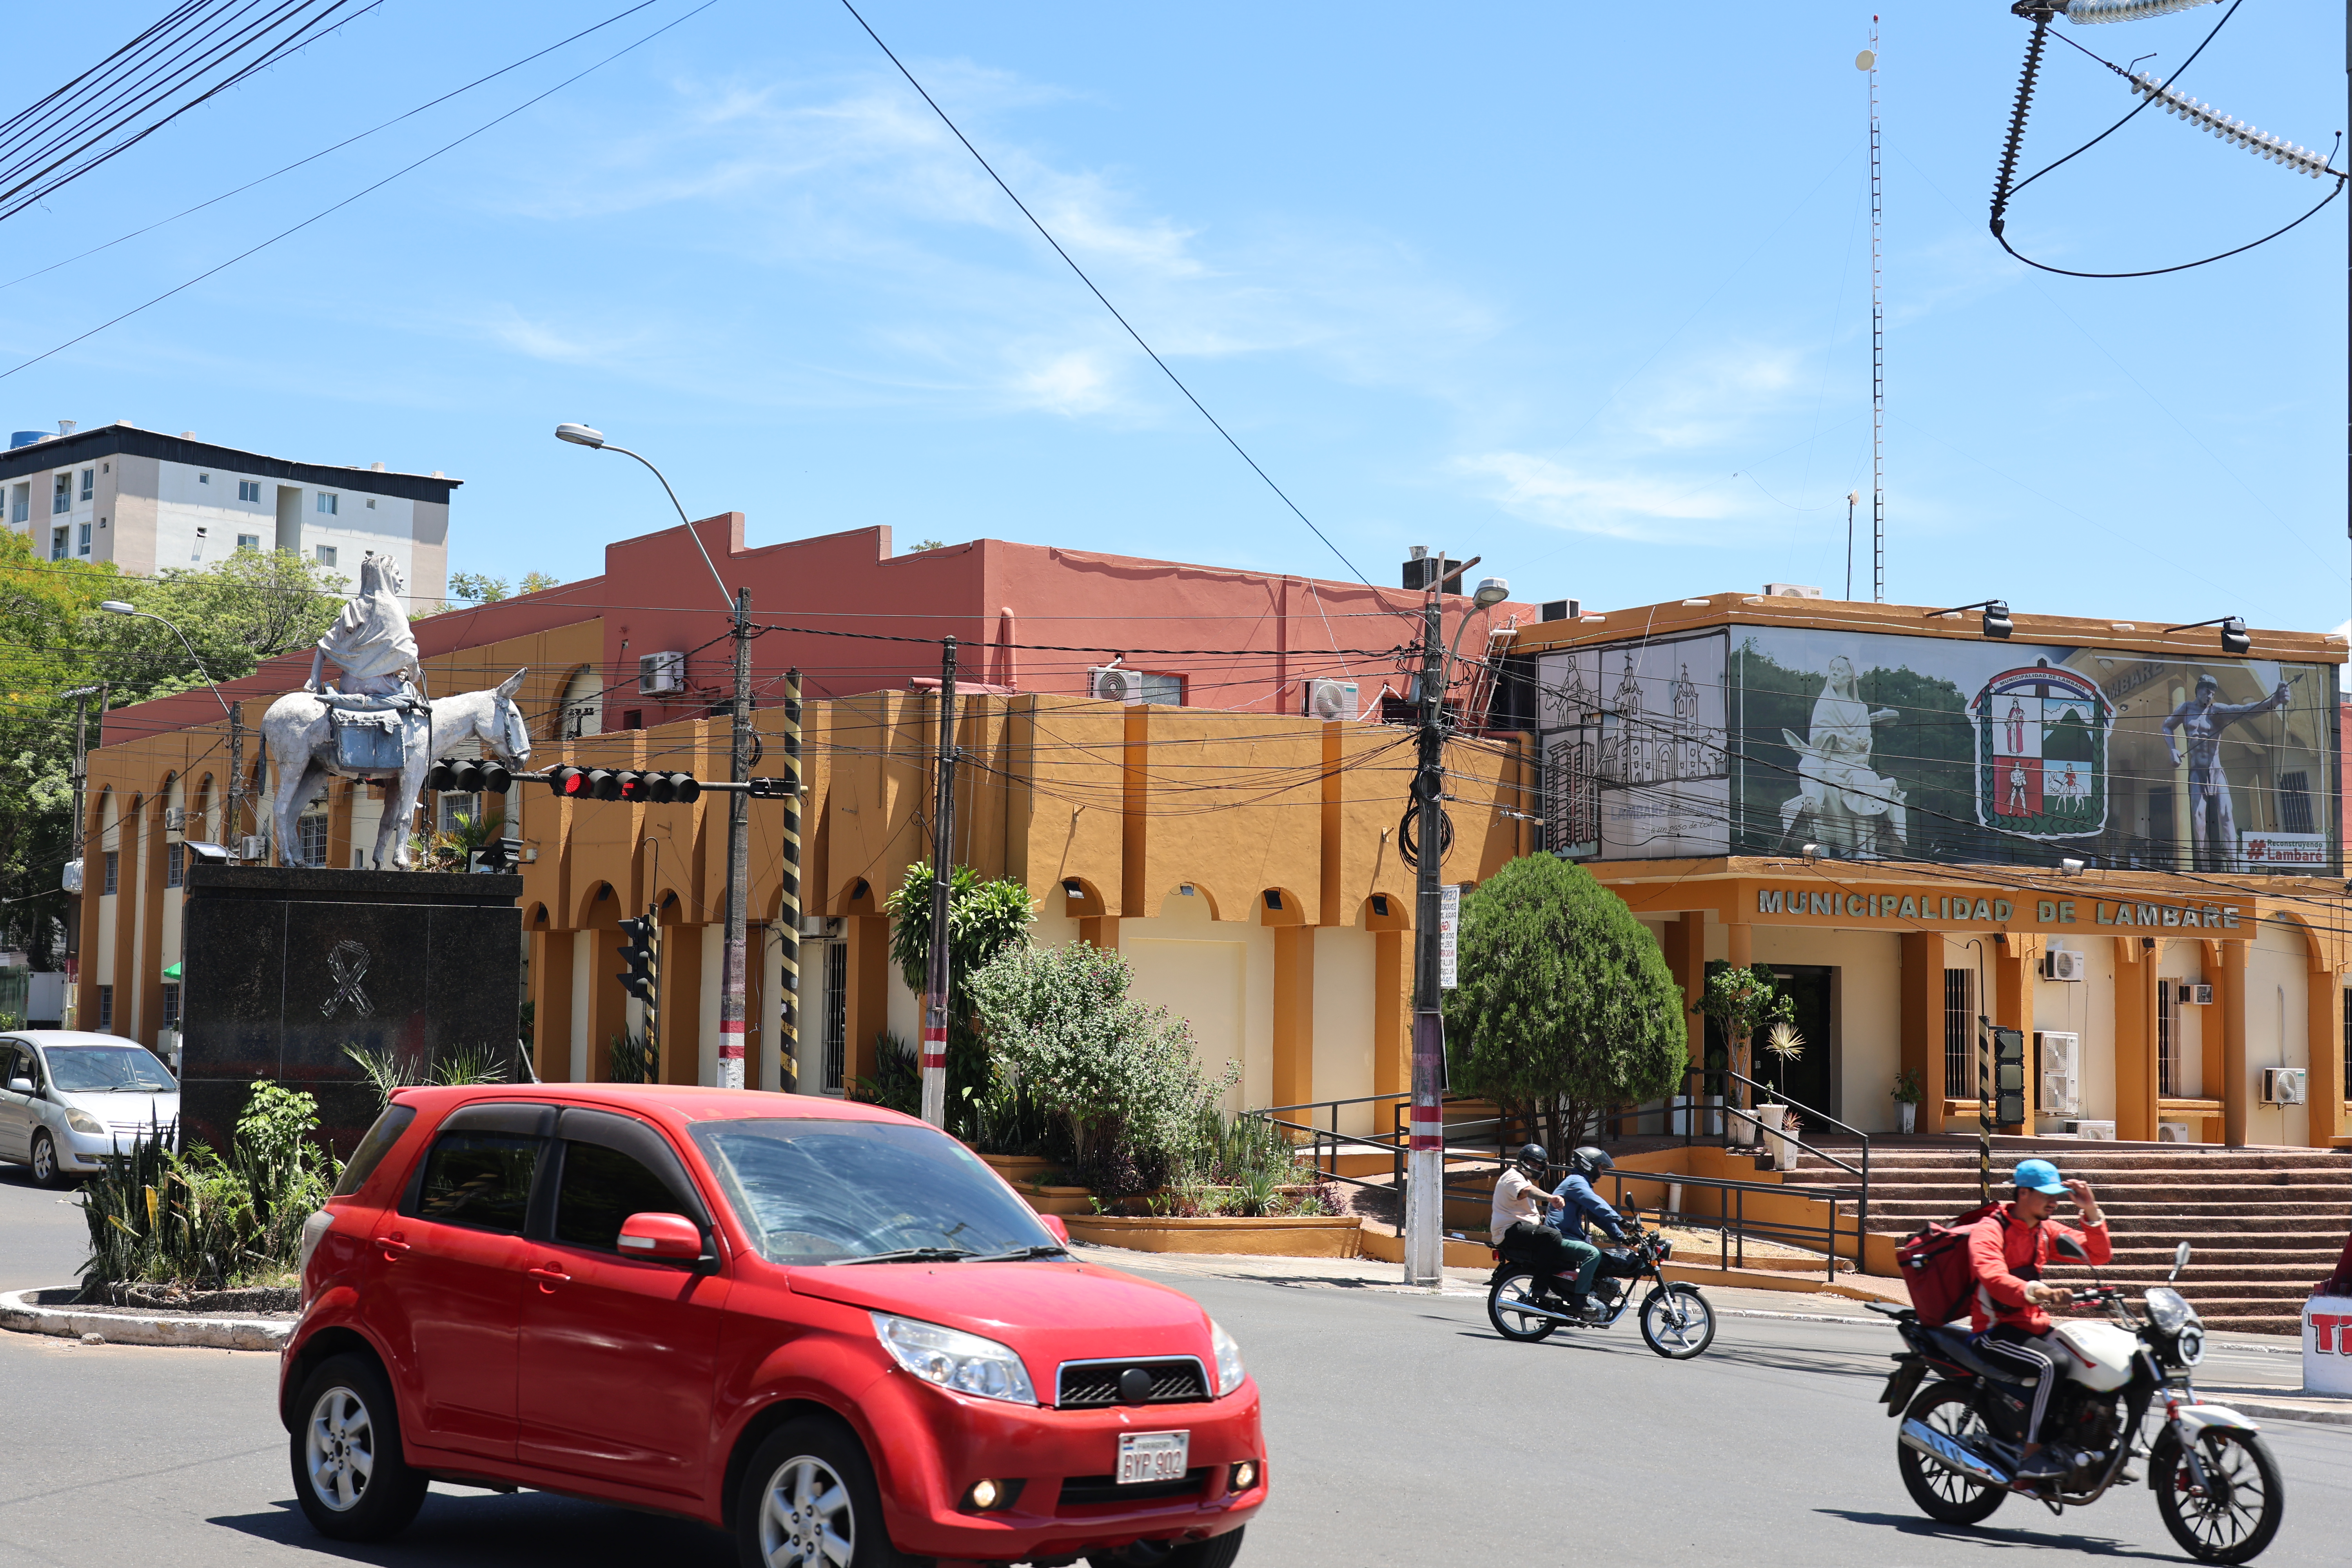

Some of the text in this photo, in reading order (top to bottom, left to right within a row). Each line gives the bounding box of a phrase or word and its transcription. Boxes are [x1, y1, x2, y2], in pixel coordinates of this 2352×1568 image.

[2000, 673, 2047, 686] MUNICIPALIDAD
[2058, 677, 2086, 692] LAMBARE
[1611, 801, 1666, 820] LAMBARÉ
[1668, 824, 1687, 835] paso
[1689, 821, 1697, 829] de
[1700, 818, 1718, 828] todo
[2267, 839, 2323, 849] Reconstruyendo
[2268, 848, 2323, 862] Lambaré
[1759, 890, 2240, 928] MUNICIPALIDAD DE LAMBARE
[1124, 1449, 1181, 1478] BYP 902
